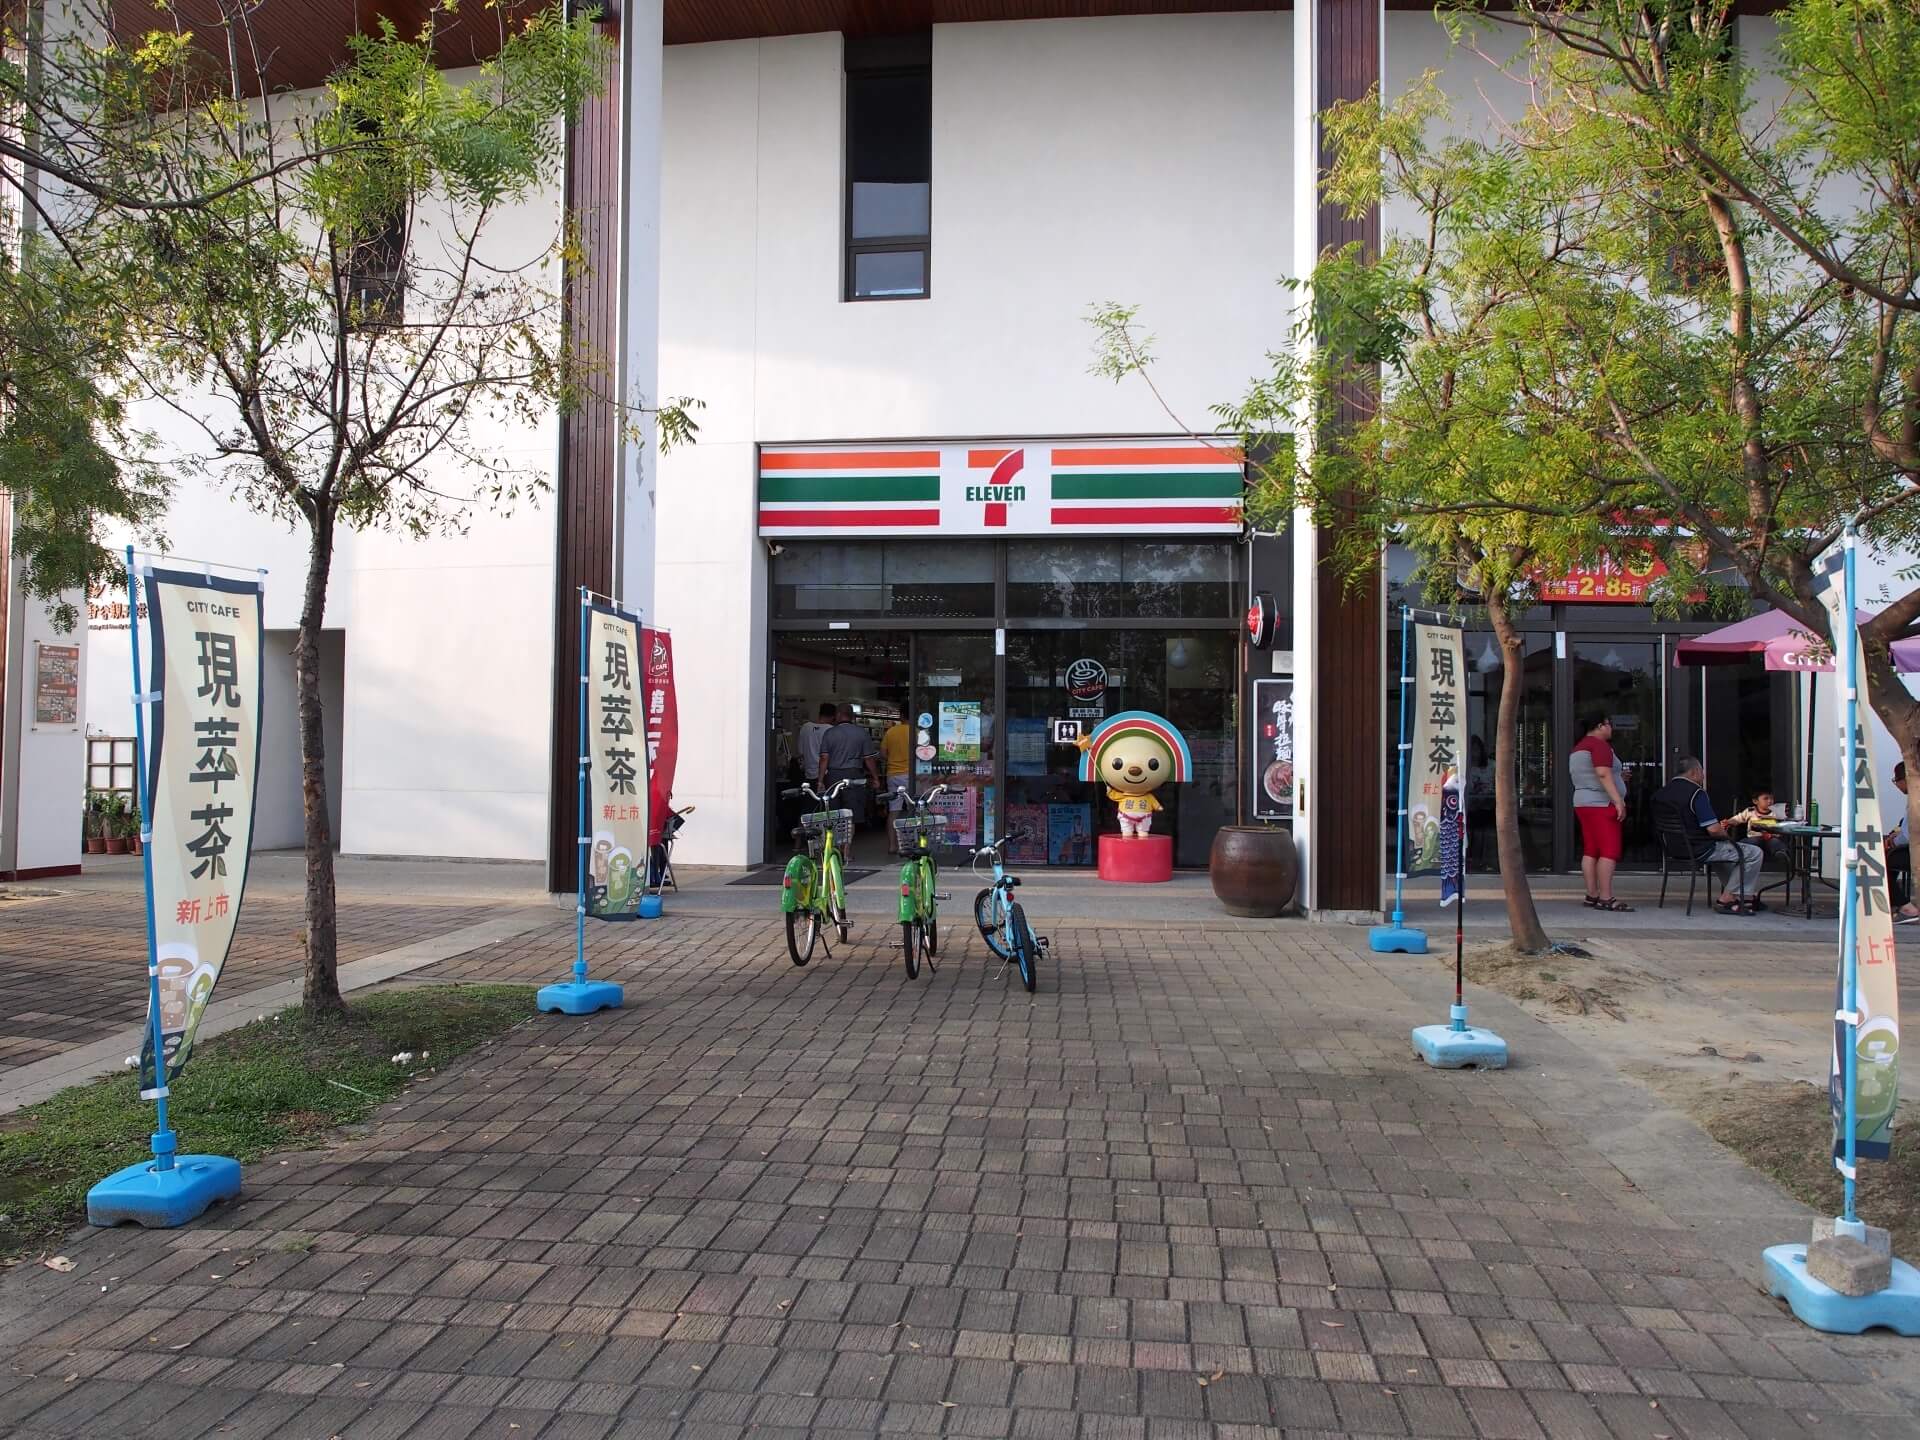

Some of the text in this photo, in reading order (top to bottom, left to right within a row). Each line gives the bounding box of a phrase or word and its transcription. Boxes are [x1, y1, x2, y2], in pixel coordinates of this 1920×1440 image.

[187, 600, 241, 619] CITY CAFE
[603, 622, 628, 637] CITY CAFE
[1426, 632, 1455, 642] CITY CAFE
[1071, 683, 1105, 695] CITY CAFE
[600, 641, 638, 796] 現萃茶
[1428, 647, 1456, 775] 現萃茶
[186, 631, 242, 881] 現萃茶
[602, 804, 640, 822] 新上市
[176, 893, 230, 926] 新上市
